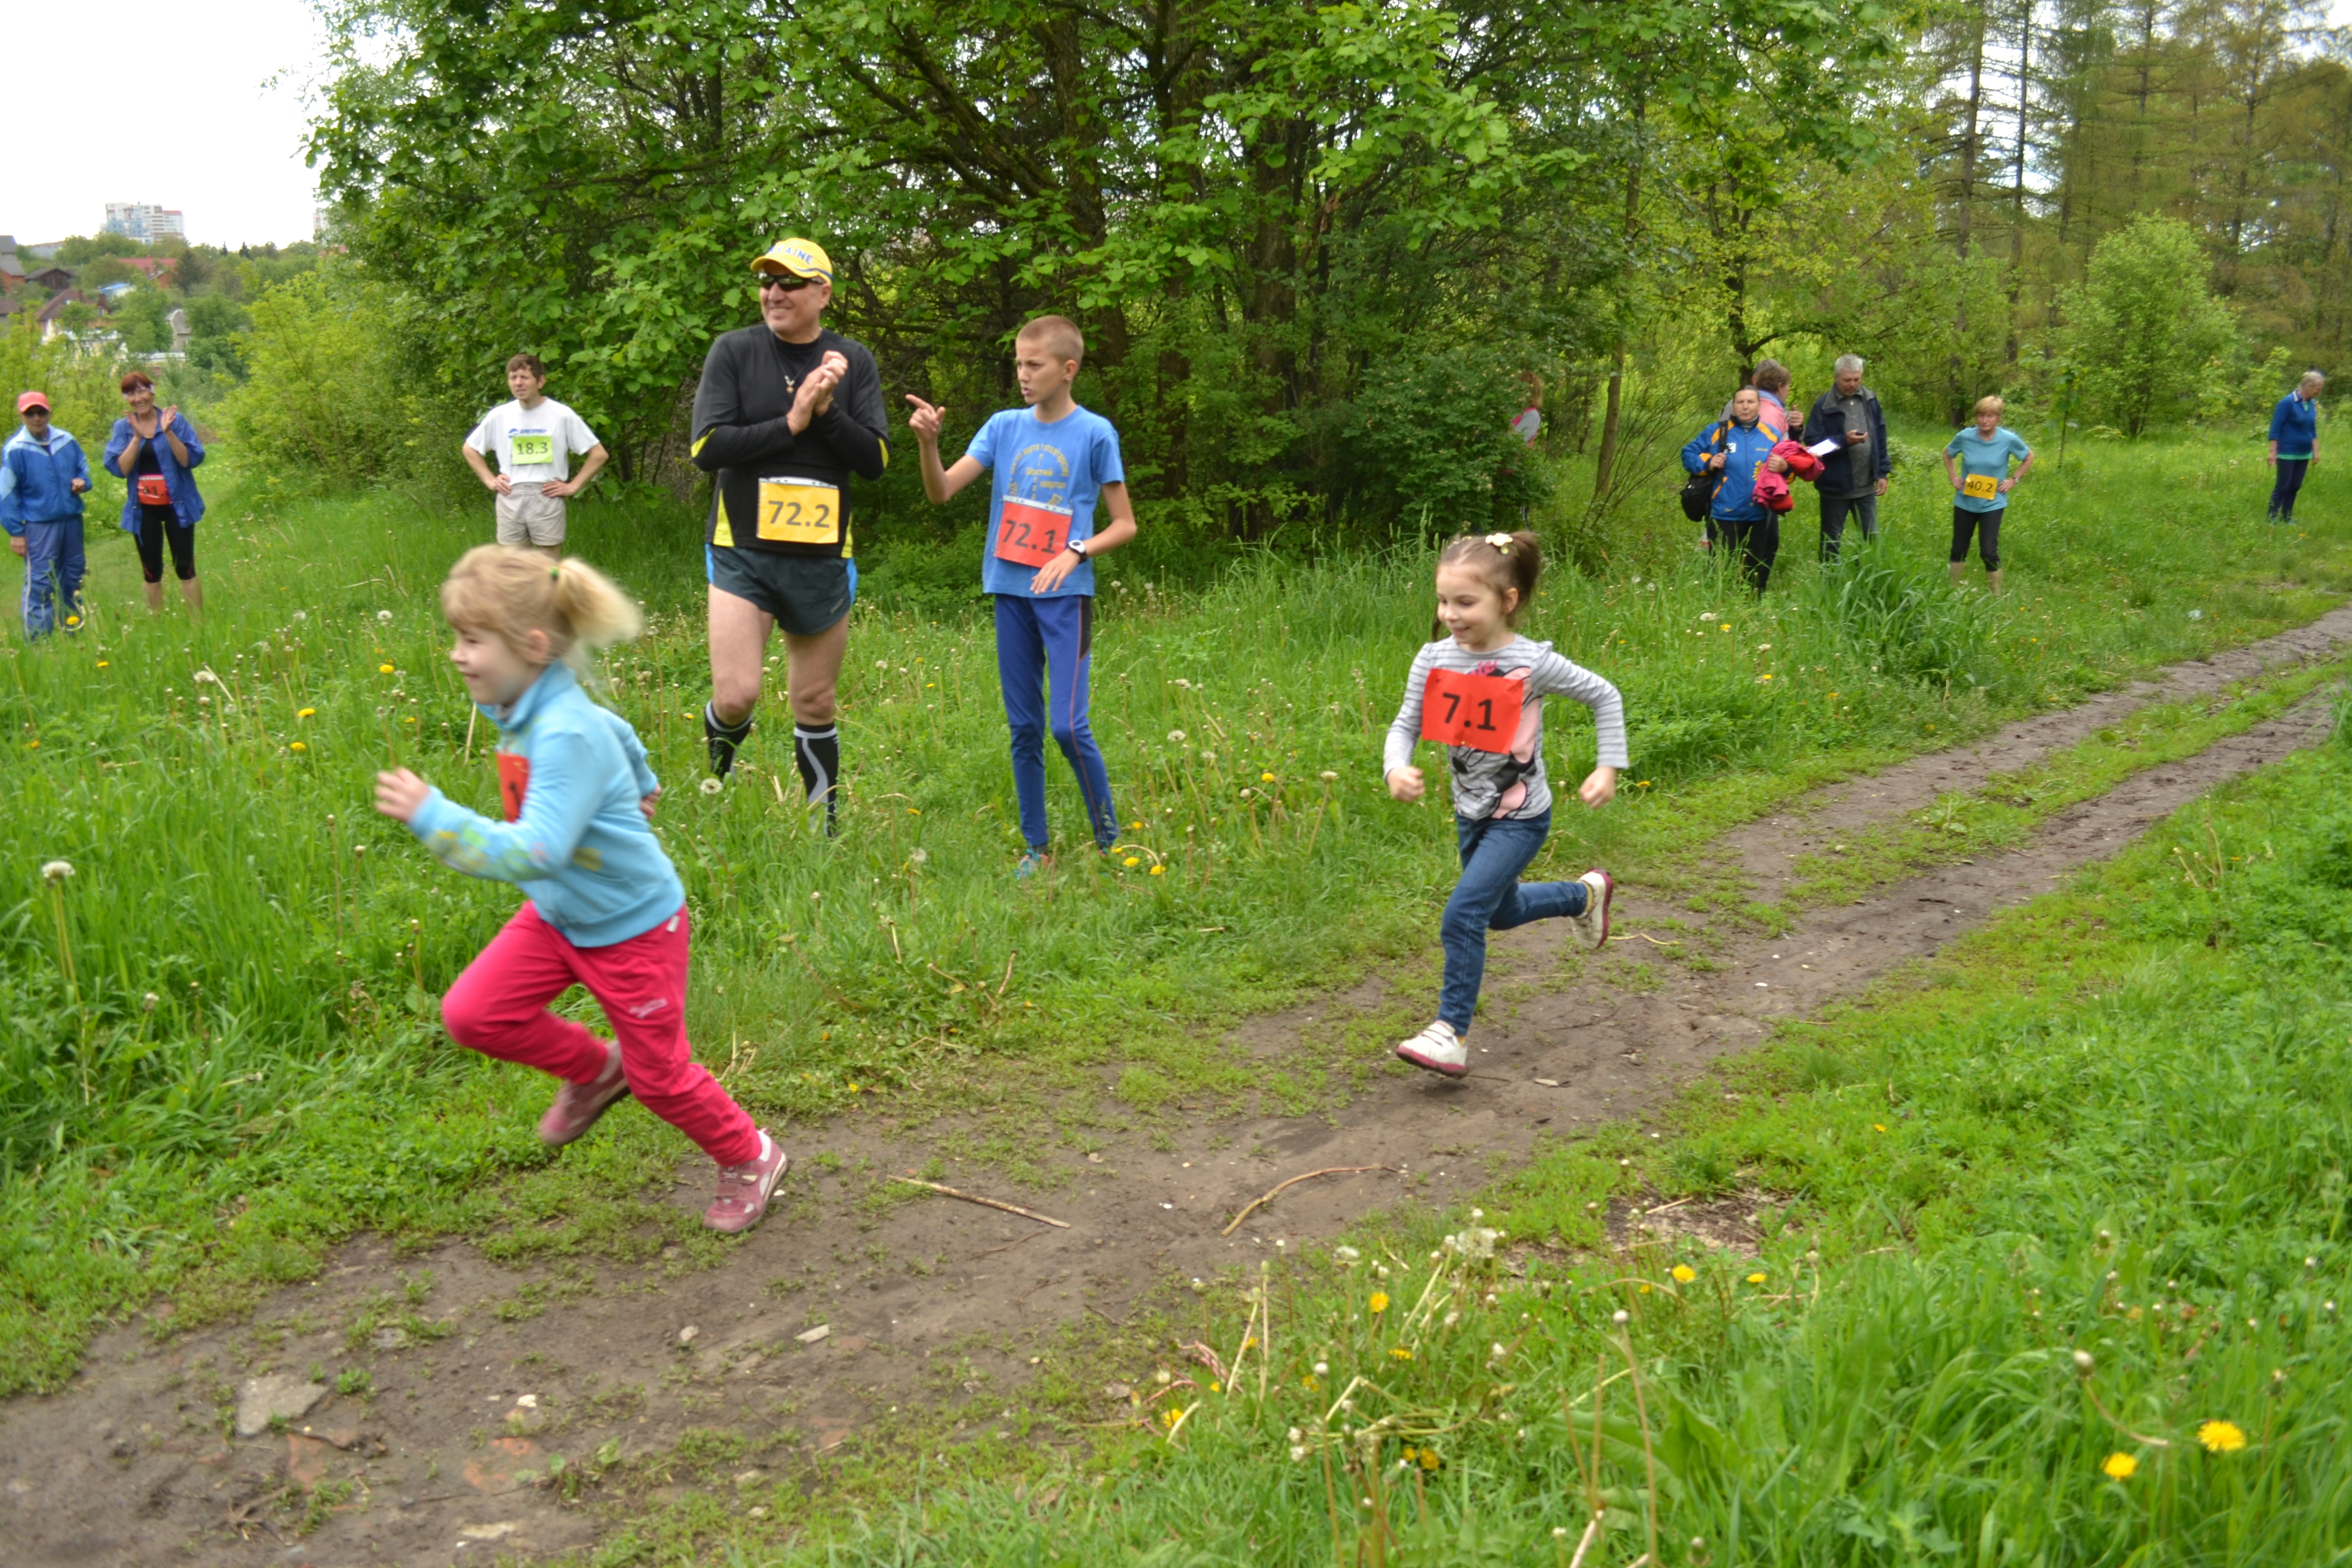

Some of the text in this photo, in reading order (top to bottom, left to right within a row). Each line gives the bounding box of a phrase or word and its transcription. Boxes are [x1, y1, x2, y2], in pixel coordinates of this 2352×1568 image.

[517, 442, 548, 455] 18.3
[1967, 481, 1993, 493] 40.2
[768, 500, 830, 528] 72.2
[1003, 520, 1056, 554] 72.1
[1442, 692, 1497, 731] 7.1
